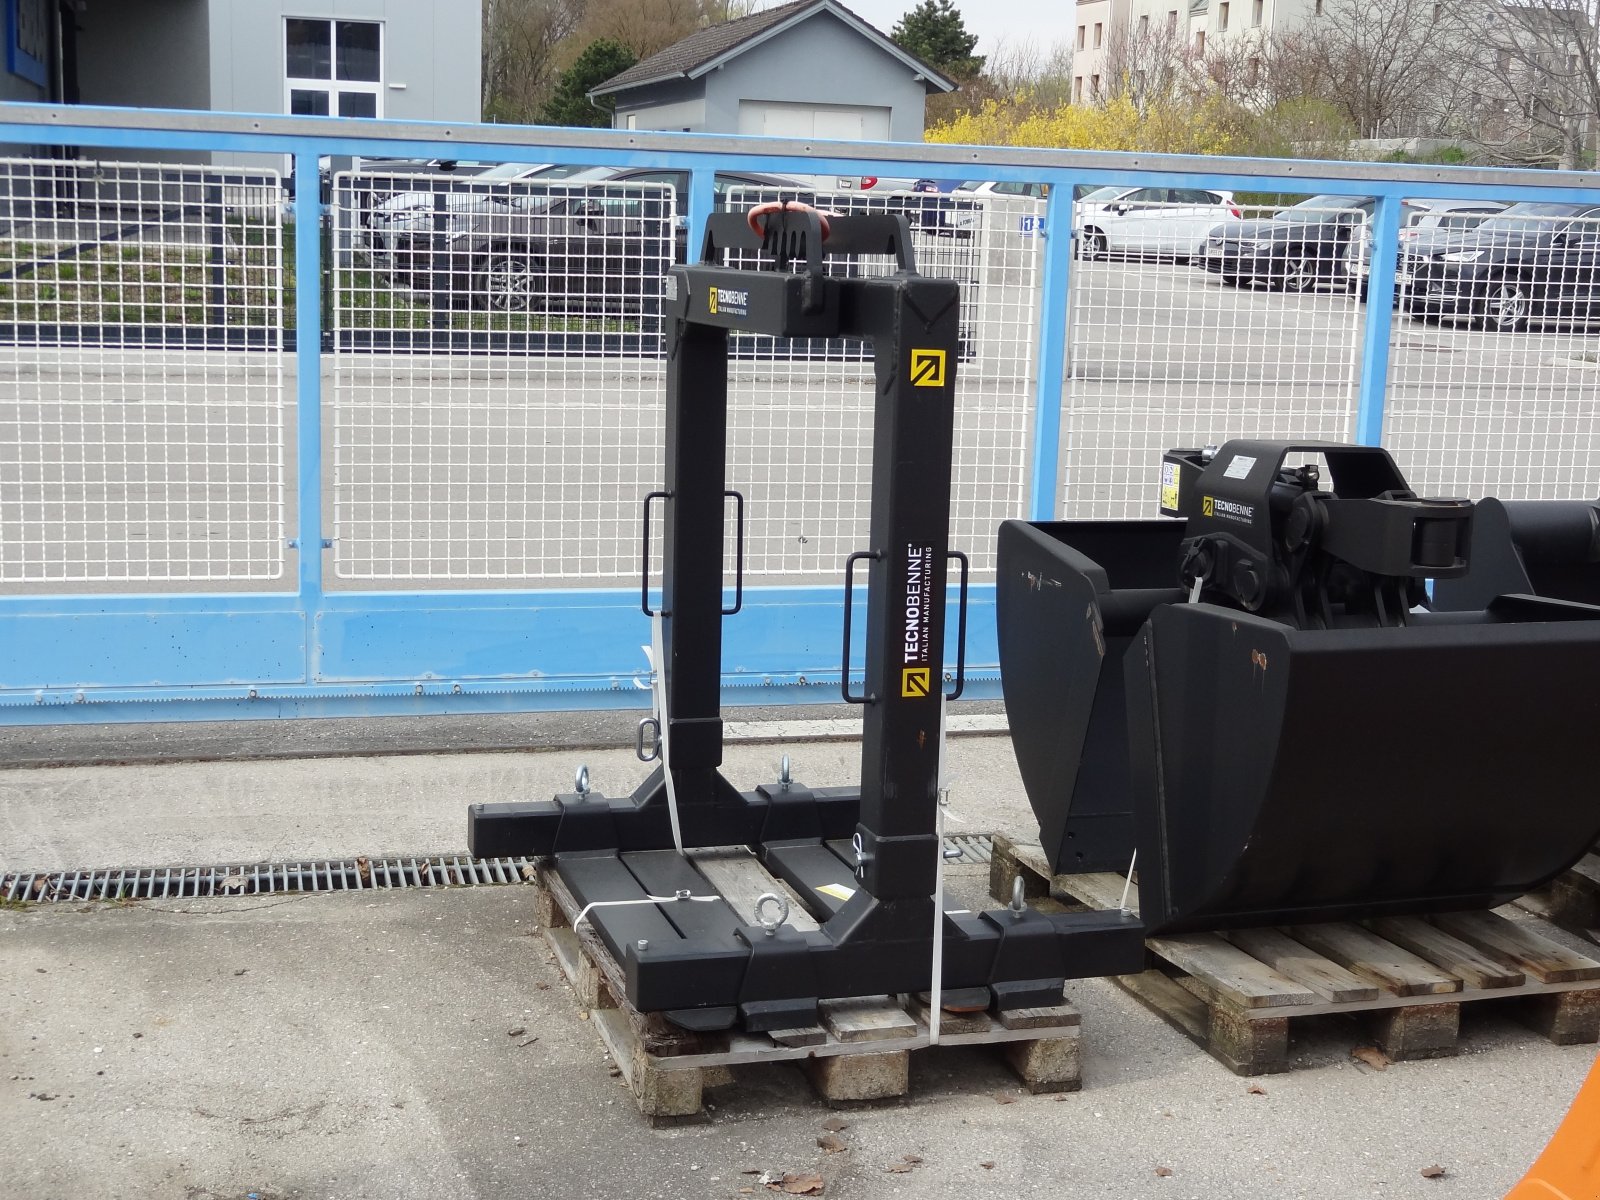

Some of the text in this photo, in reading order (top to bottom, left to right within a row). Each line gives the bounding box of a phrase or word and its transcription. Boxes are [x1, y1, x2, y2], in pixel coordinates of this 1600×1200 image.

[1214, 499, 1254, 517] TECNOBENNE
[921, 546, 932, 662] ITALIAN MANUFACTURING
